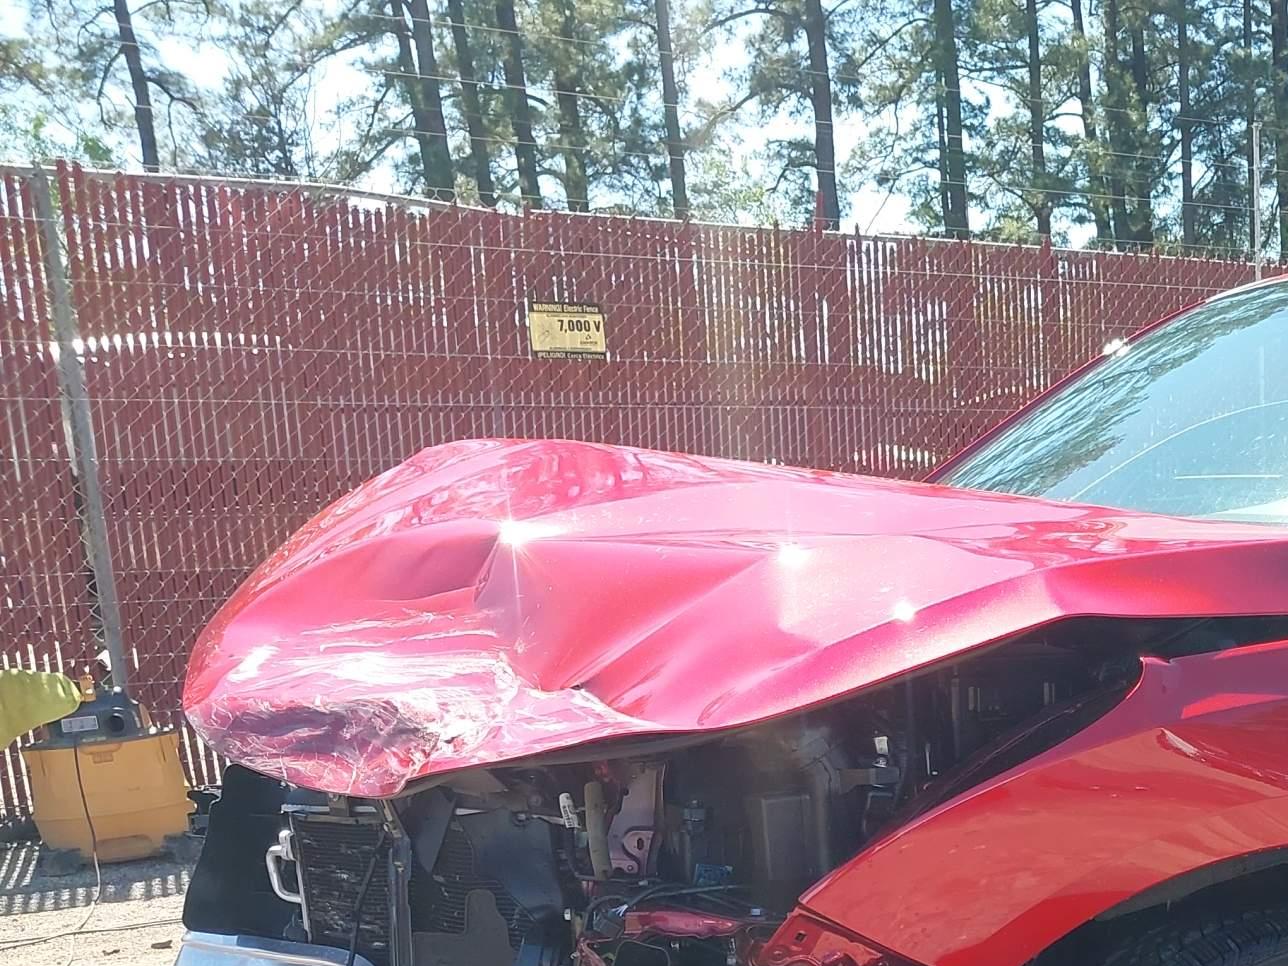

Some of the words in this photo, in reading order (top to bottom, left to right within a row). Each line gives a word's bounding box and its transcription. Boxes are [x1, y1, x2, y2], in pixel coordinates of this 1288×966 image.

[563, 304, 582, 312] Electric
[583, 305, 599, 313] Fence
[557, 319, 591, 333] 7,000
[593, 320, 601, 333] V
